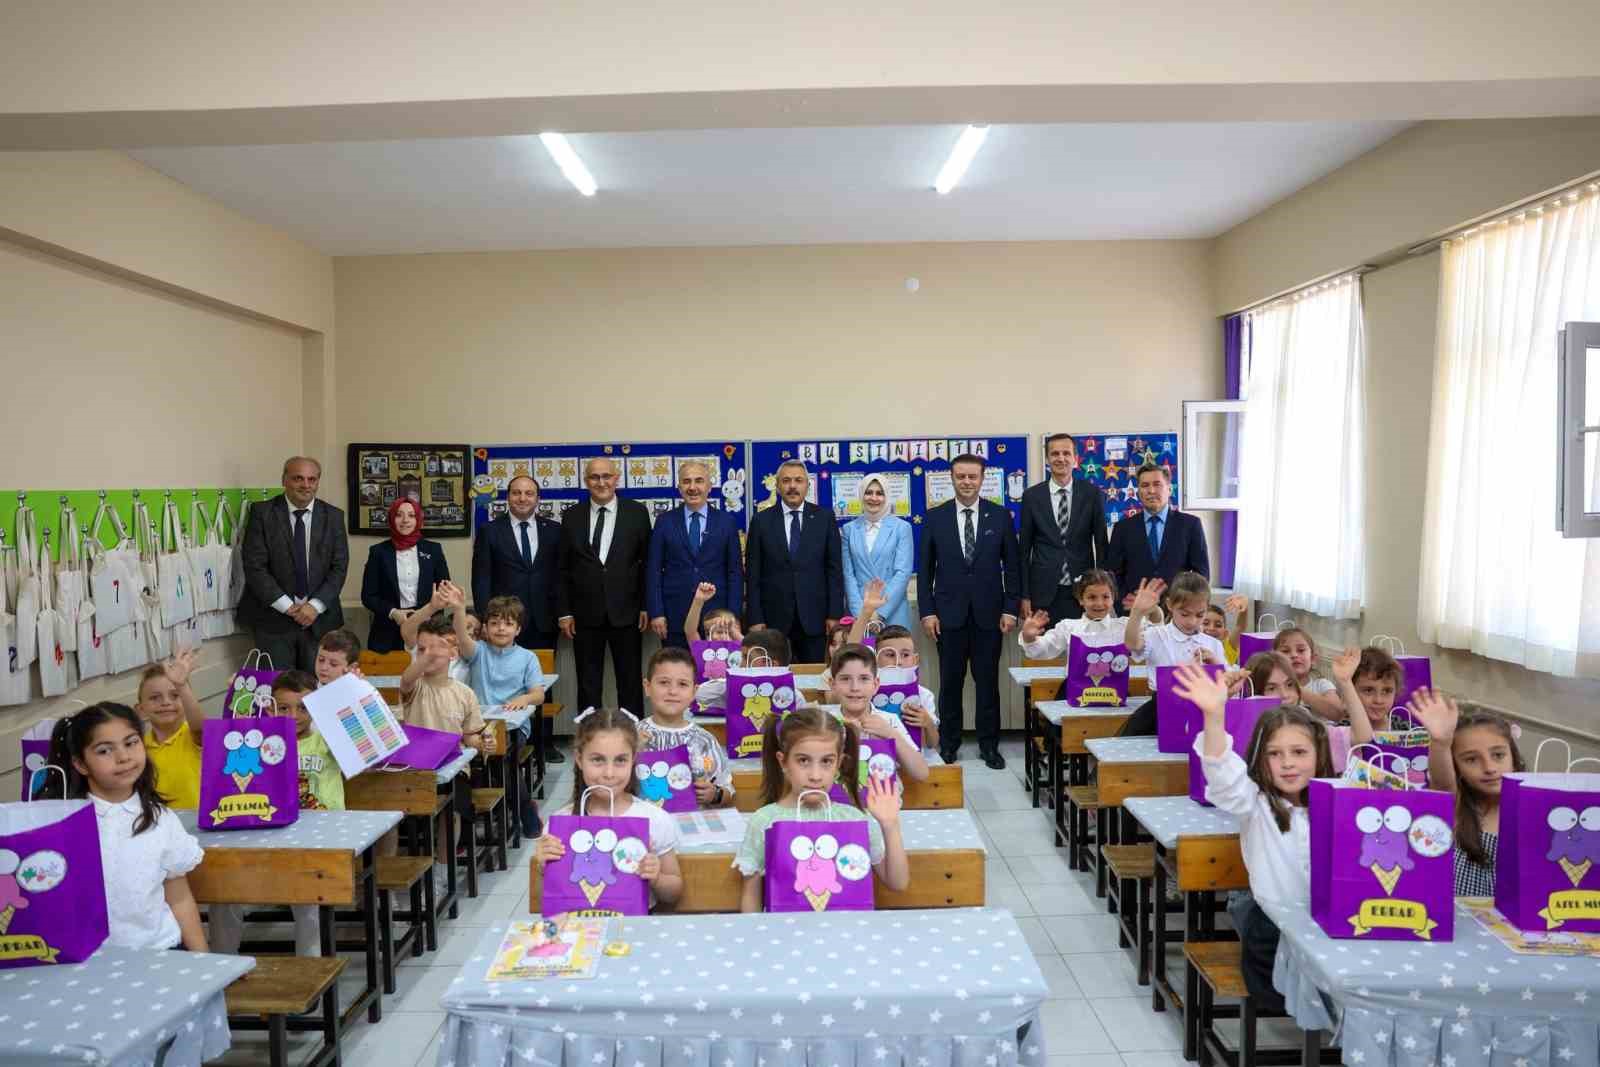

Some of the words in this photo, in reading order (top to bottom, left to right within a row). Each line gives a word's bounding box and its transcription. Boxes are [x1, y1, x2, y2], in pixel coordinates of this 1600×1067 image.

[804, 446, 834, 458] BU
[856, 441, 984, 458] SINIFTA
[542, 476, 549, 488] 6
[564, 476, 571, 487] 8
[632, 475, 647, 488] 14
[656, 475, 667, 486] 16
